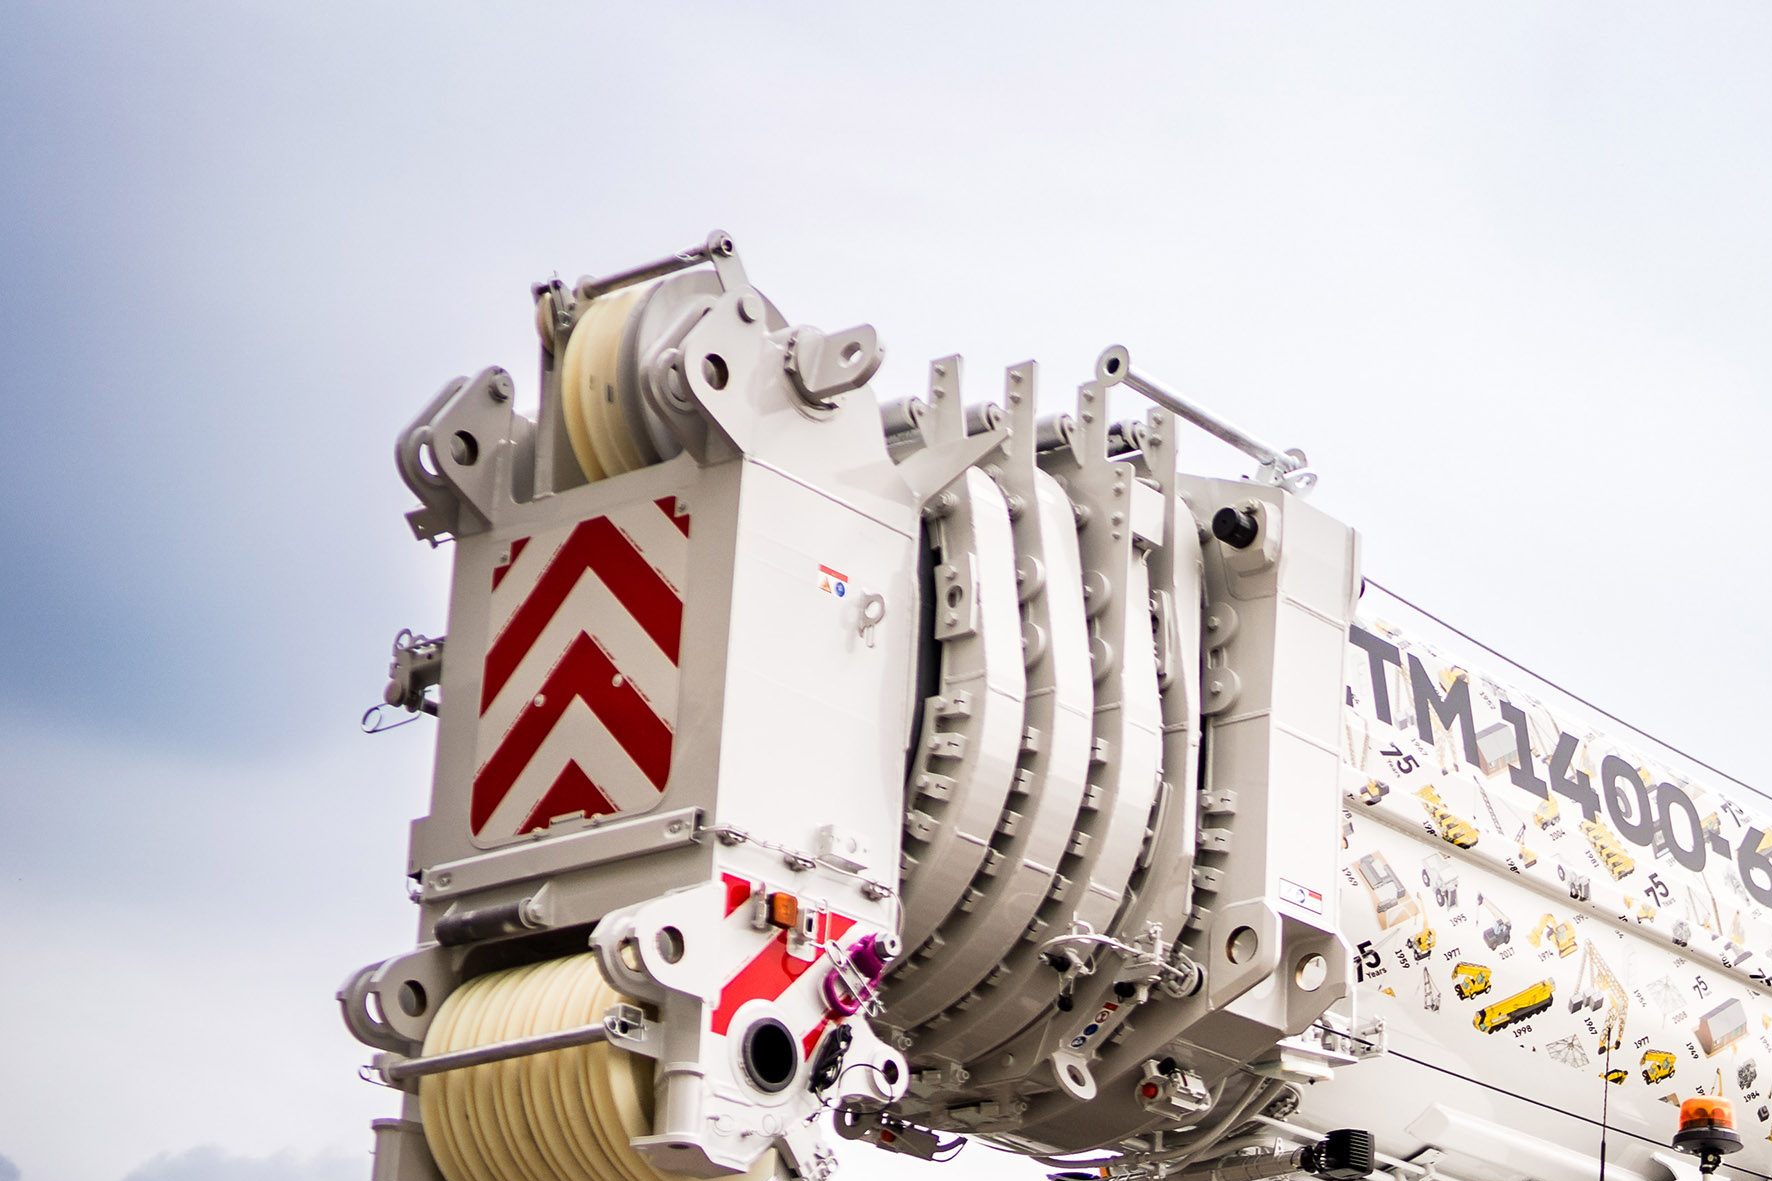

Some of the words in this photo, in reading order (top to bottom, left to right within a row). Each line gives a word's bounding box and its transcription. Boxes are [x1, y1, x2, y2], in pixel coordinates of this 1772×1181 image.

[1346, 624, 1480, 768] TM
[1380, 742, 1420, 775] 75
[1394, 949, 1410, 969] 1959
[1444, 947, 1461, 961] 1977
[1513, 1024, 1533, 1038] 1998
[1634, 1036, 1650, 1050] 1977
